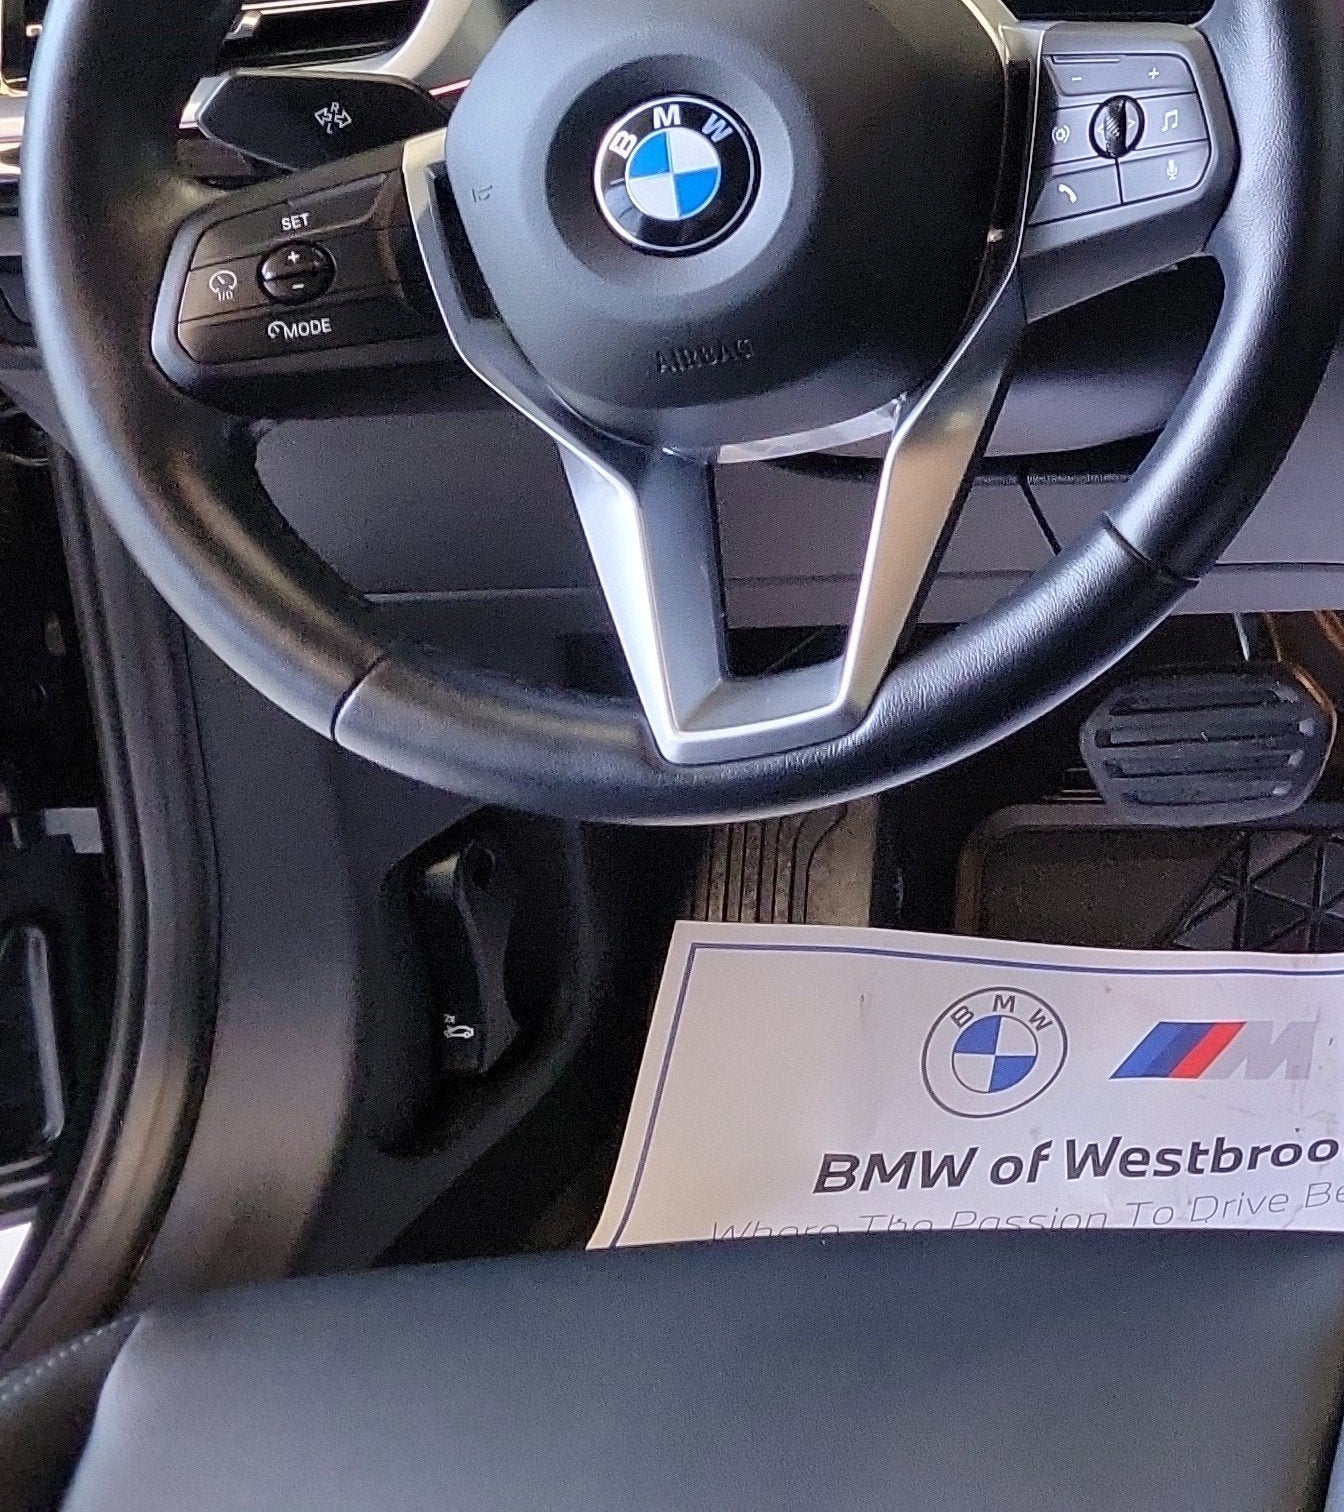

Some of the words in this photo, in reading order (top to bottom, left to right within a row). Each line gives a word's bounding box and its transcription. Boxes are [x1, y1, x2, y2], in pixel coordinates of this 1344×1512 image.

[608, 103, 734, 160] BMW
[281, 211, 311, 231] SET
[283, 317, 333, 341] MODE
[950, 994, 1056, 1033] BMW
[812, 1146, 981, 1194] BMW
[988, 1139, 1054, 1186] of
[1125, 1200, 1175, 1227] To
[1190, 1192, 1290, 1223] Drive
